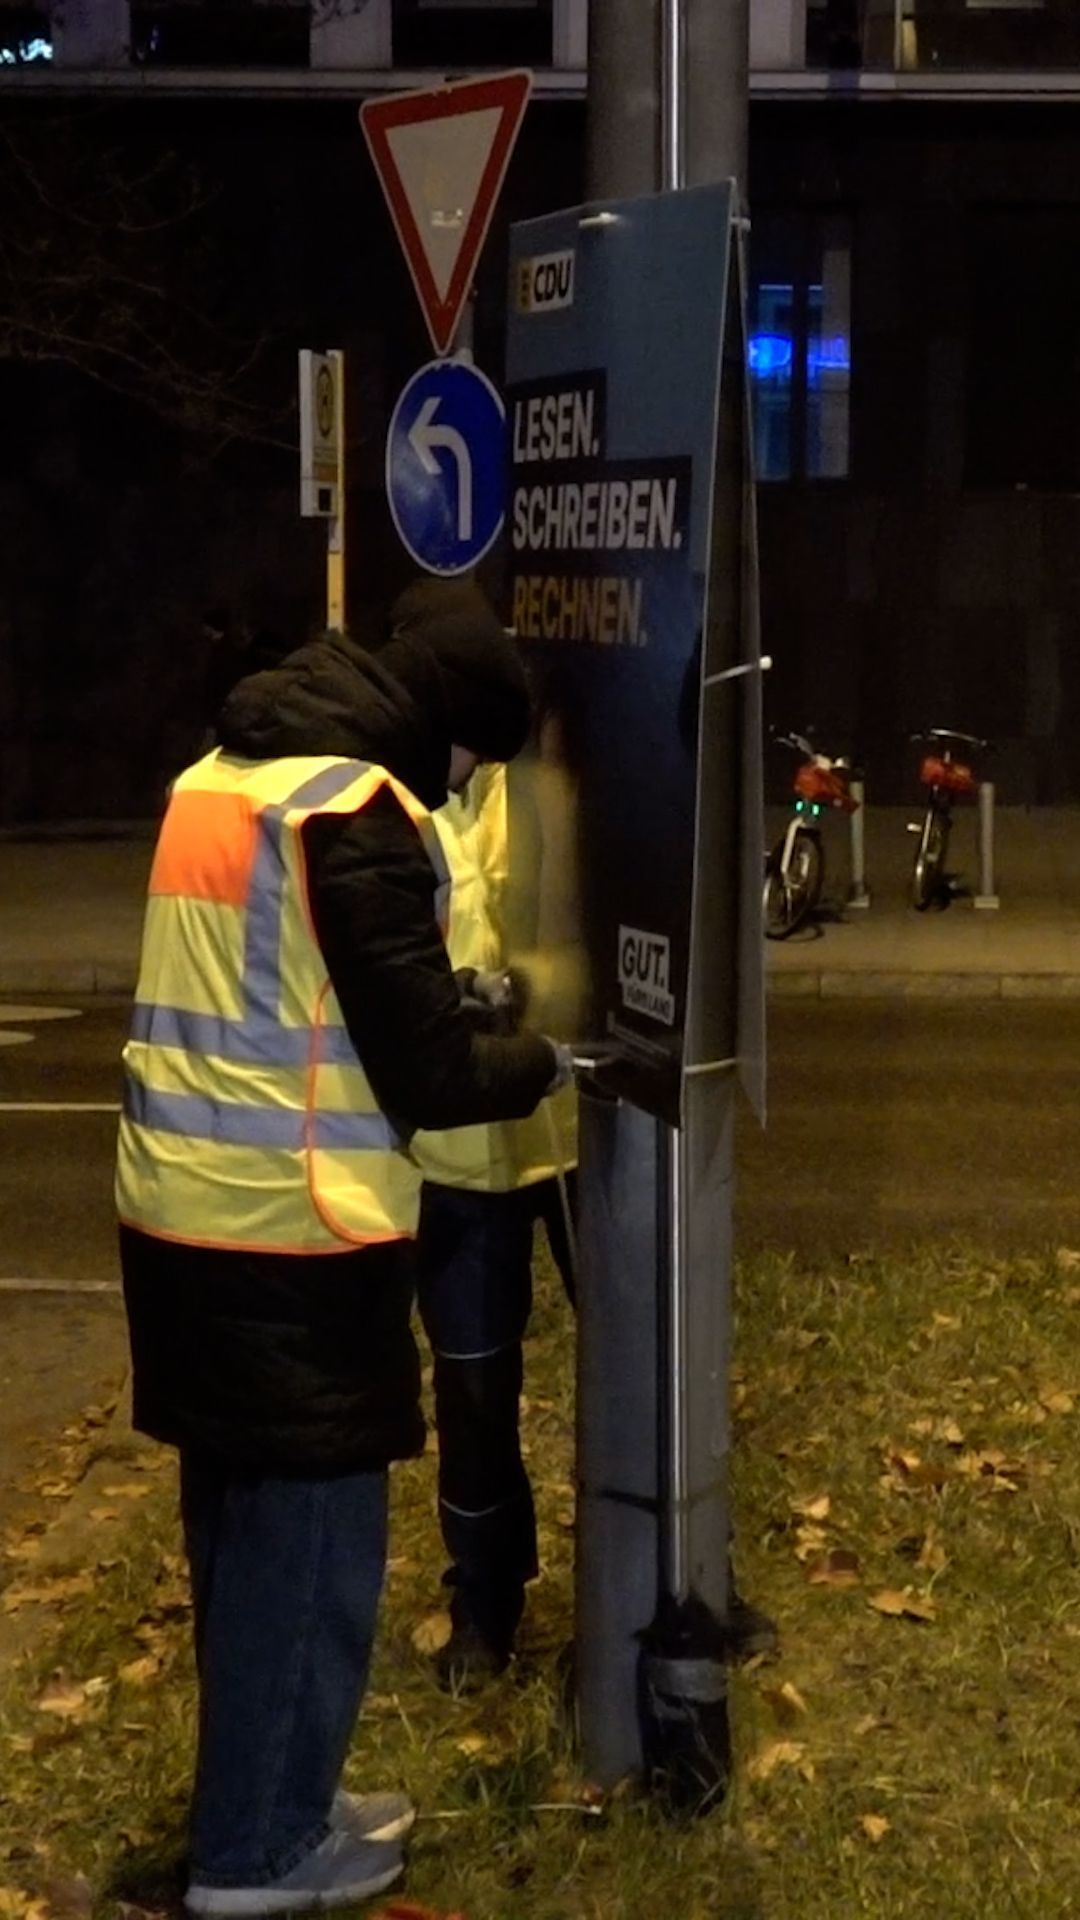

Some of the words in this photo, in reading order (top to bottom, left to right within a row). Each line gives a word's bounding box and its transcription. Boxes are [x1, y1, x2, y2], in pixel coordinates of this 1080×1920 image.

[534, 258, 572, 302] CDU
[513, 389, 599, 463] LESEN.
[513, 478, 682, 550] SCHREIBEN.
[513, 575, 648, 647] RECHNEN.
[623, 936, 666, 987] GUT.
